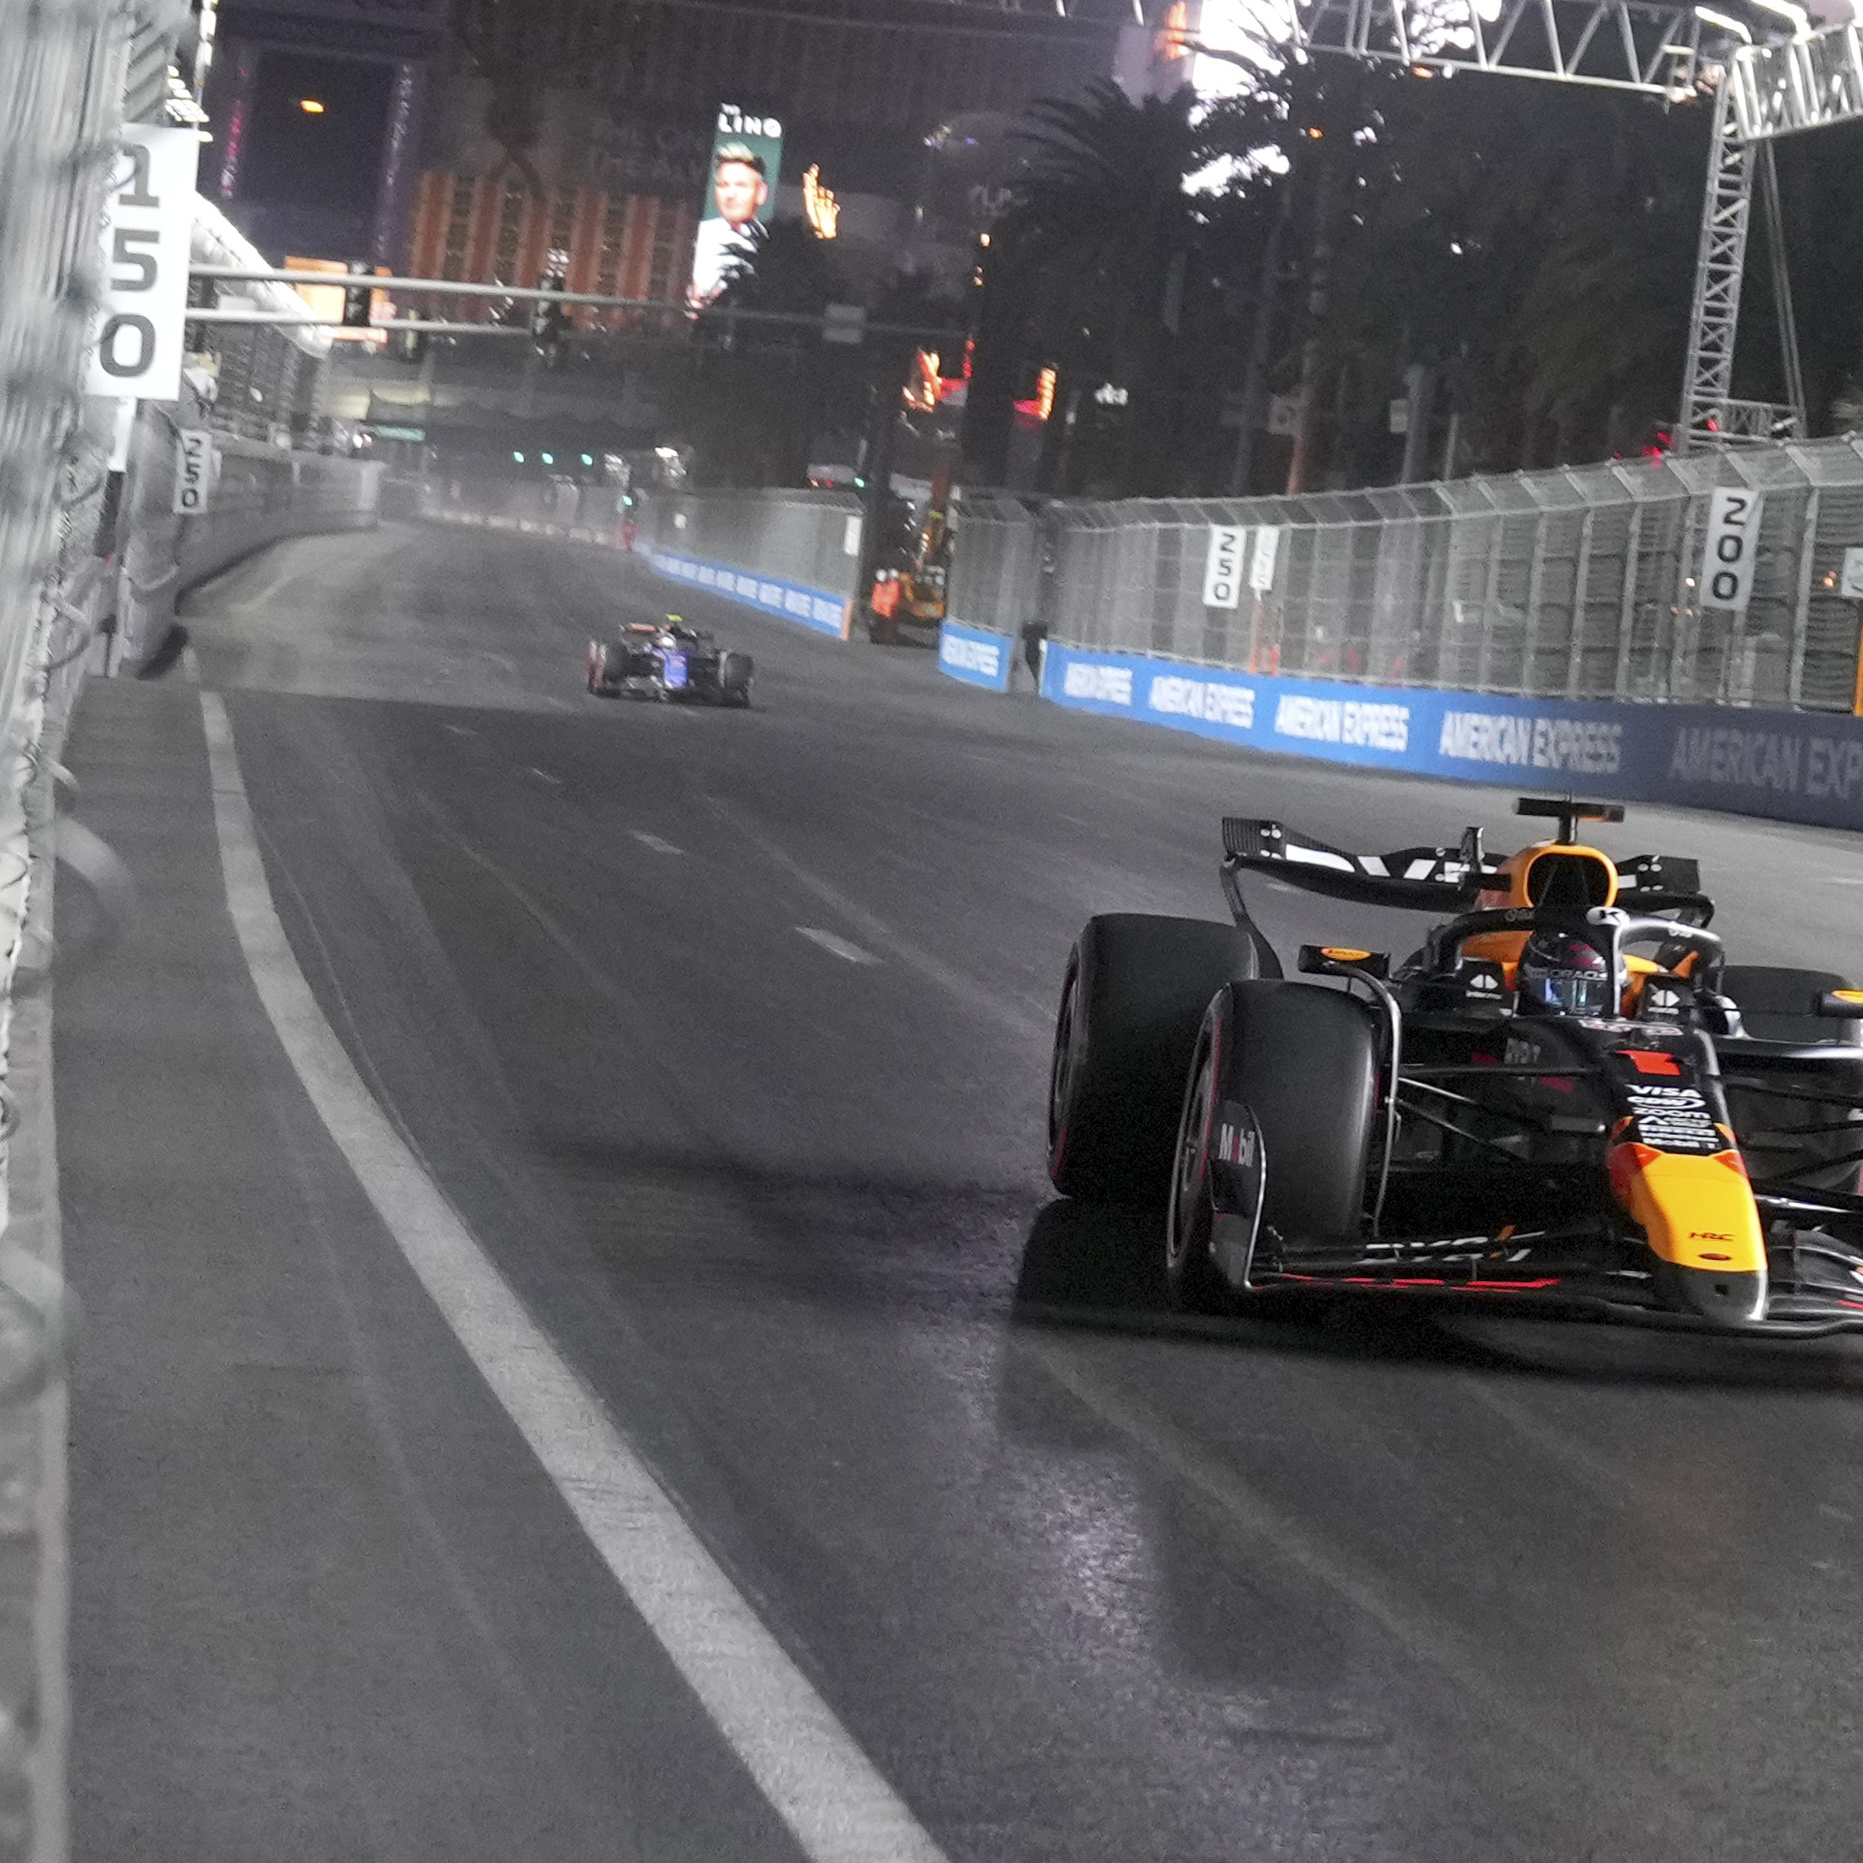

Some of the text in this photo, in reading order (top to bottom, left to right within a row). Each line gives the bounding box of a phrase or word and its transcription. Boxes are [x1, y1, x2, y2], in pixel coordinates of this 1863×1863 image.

[718, 111, 782, 138] LINQ
[100, 143, 161, 378] 150
[1213, 532, 1236, 601] 250
[1712, 497, 1748, 601] 200
[1439, 710, 1623, 774] AMERICAN EXPRESS
[1668, 727, 1803, 792] AMERICAN
[1625, 1083, 1702, 1099] VISA
